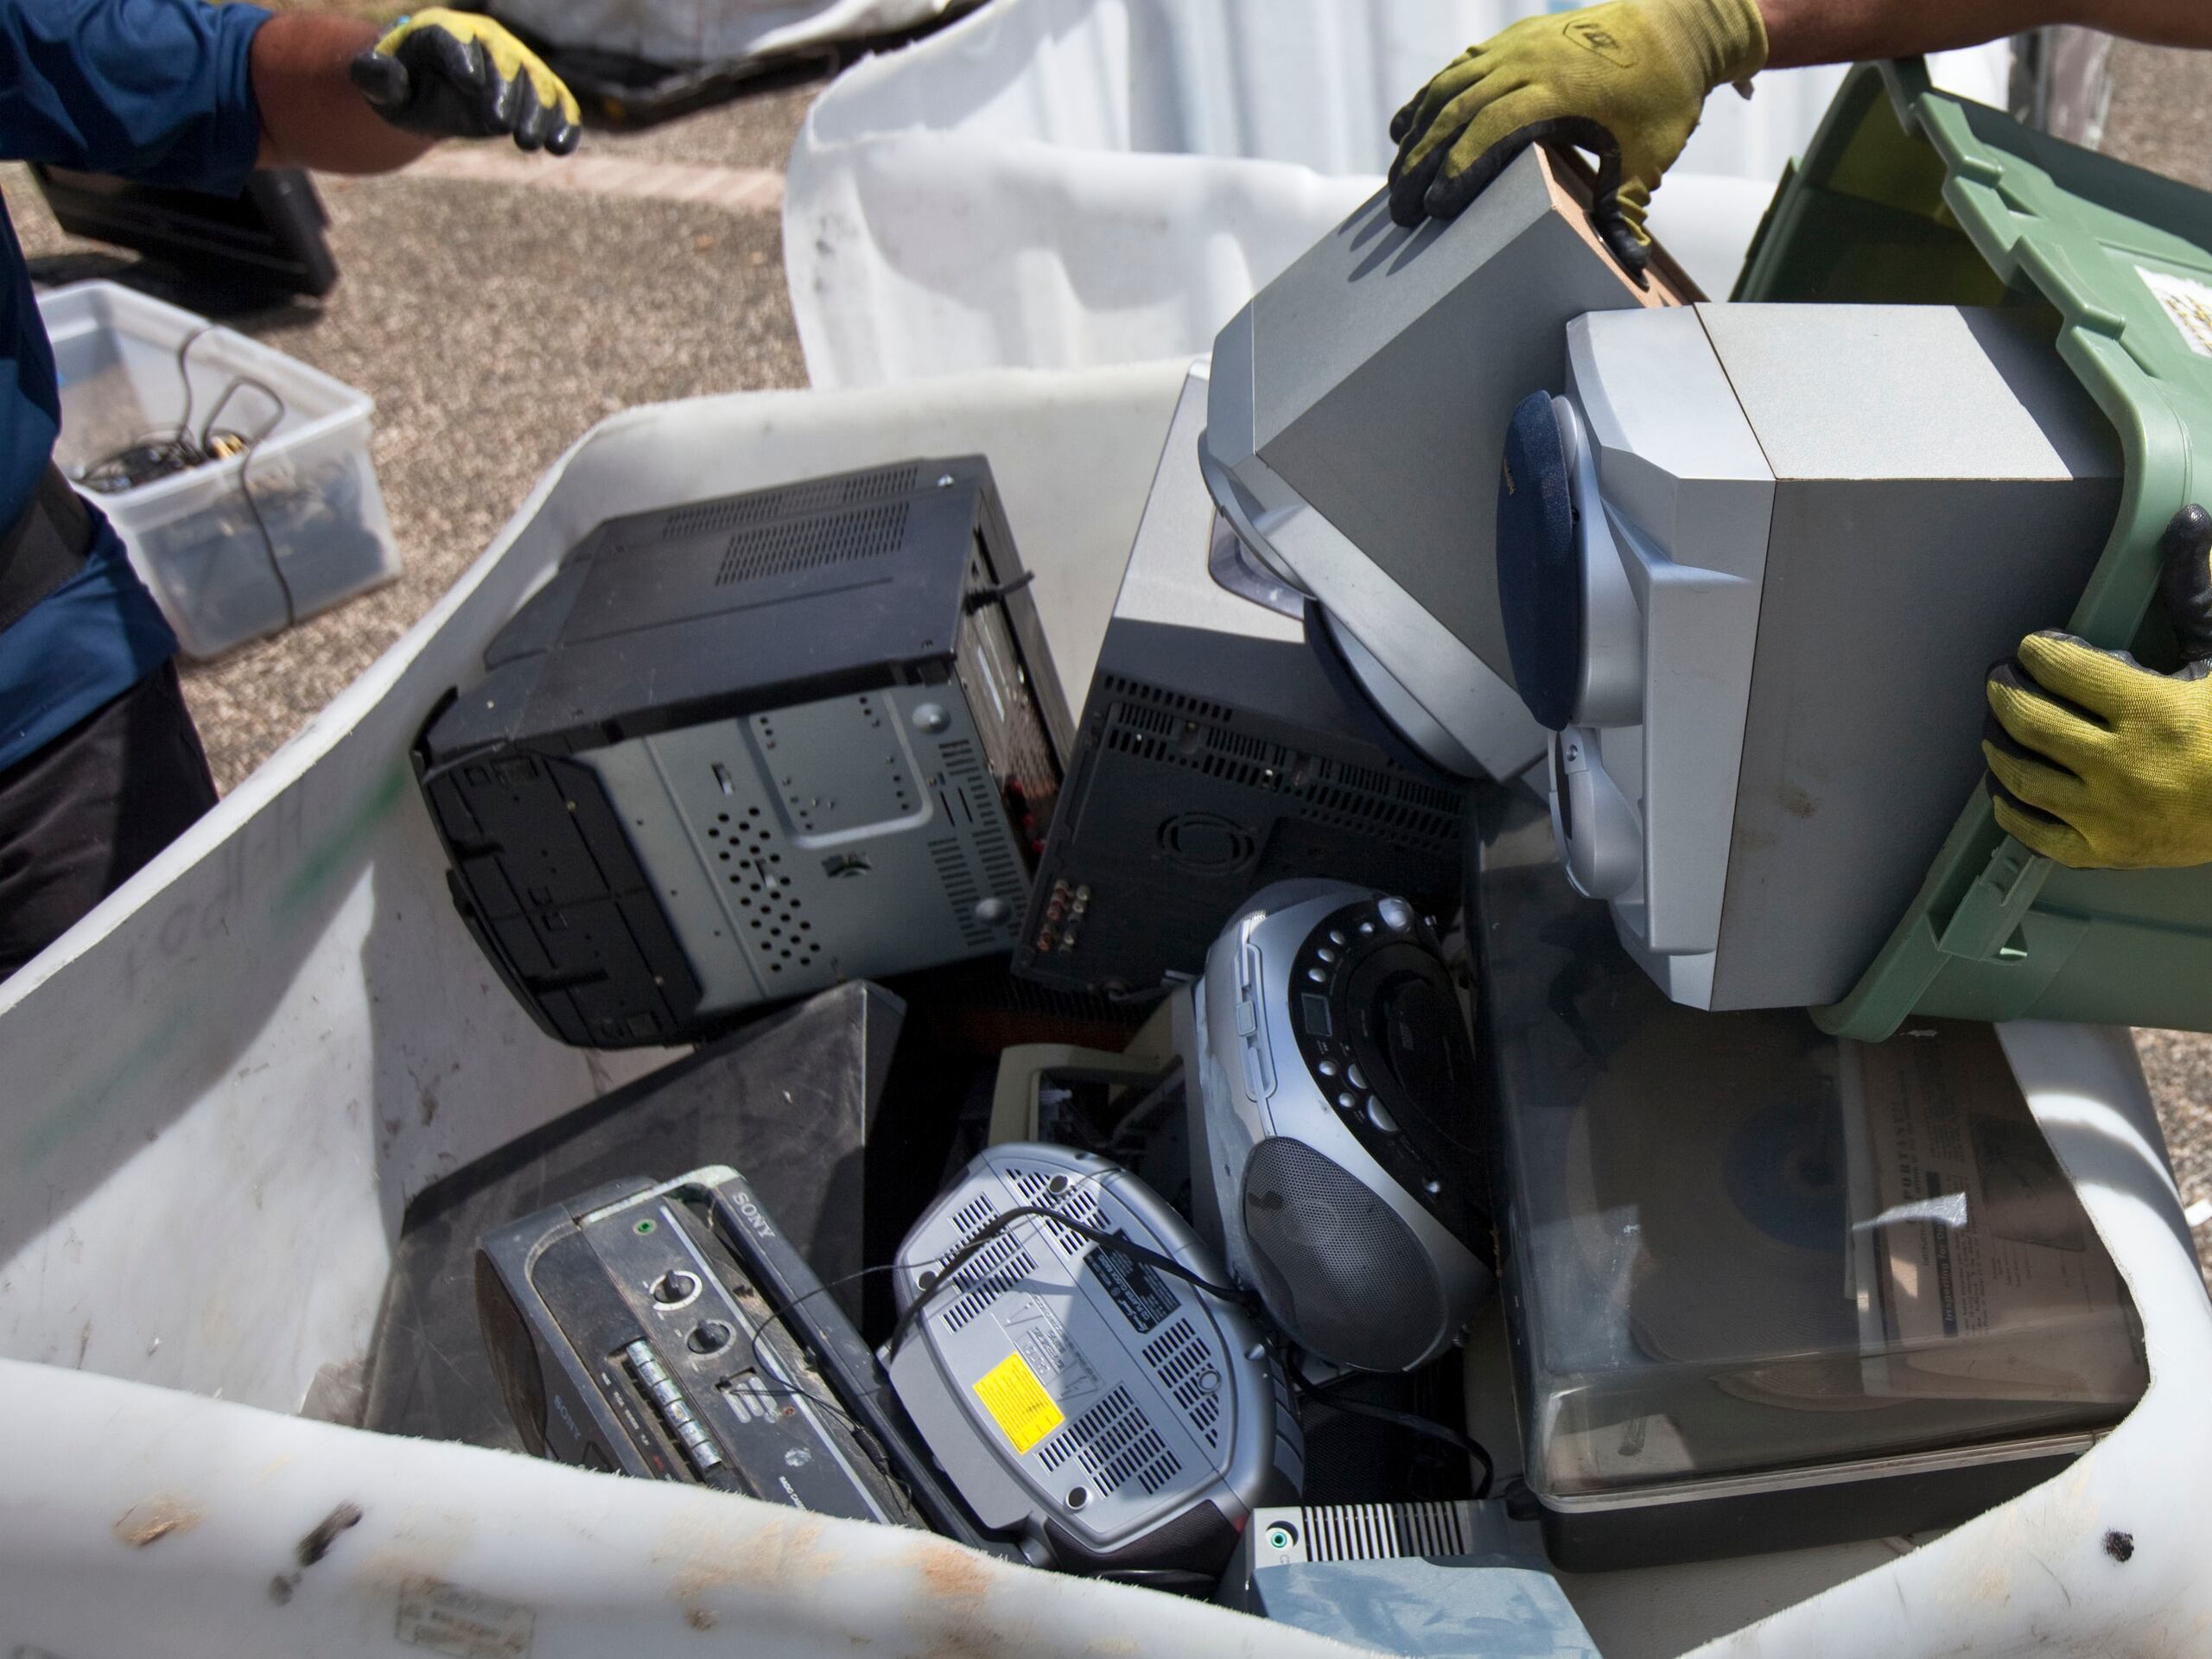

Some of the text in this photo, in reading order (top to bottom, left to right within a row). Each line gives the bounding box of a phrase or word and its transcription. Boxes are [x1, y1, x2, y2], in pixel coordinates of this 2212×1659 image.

[732, 1191, 775, 1239] SONY
[1110, 1271, 1128, 1292] CLOCK
[1124, 1290, 1145, 1313] PLAYER
[1940, 1262, 1955, 1322] Inspecting
[554, 1394, 582, 1440] SONY
